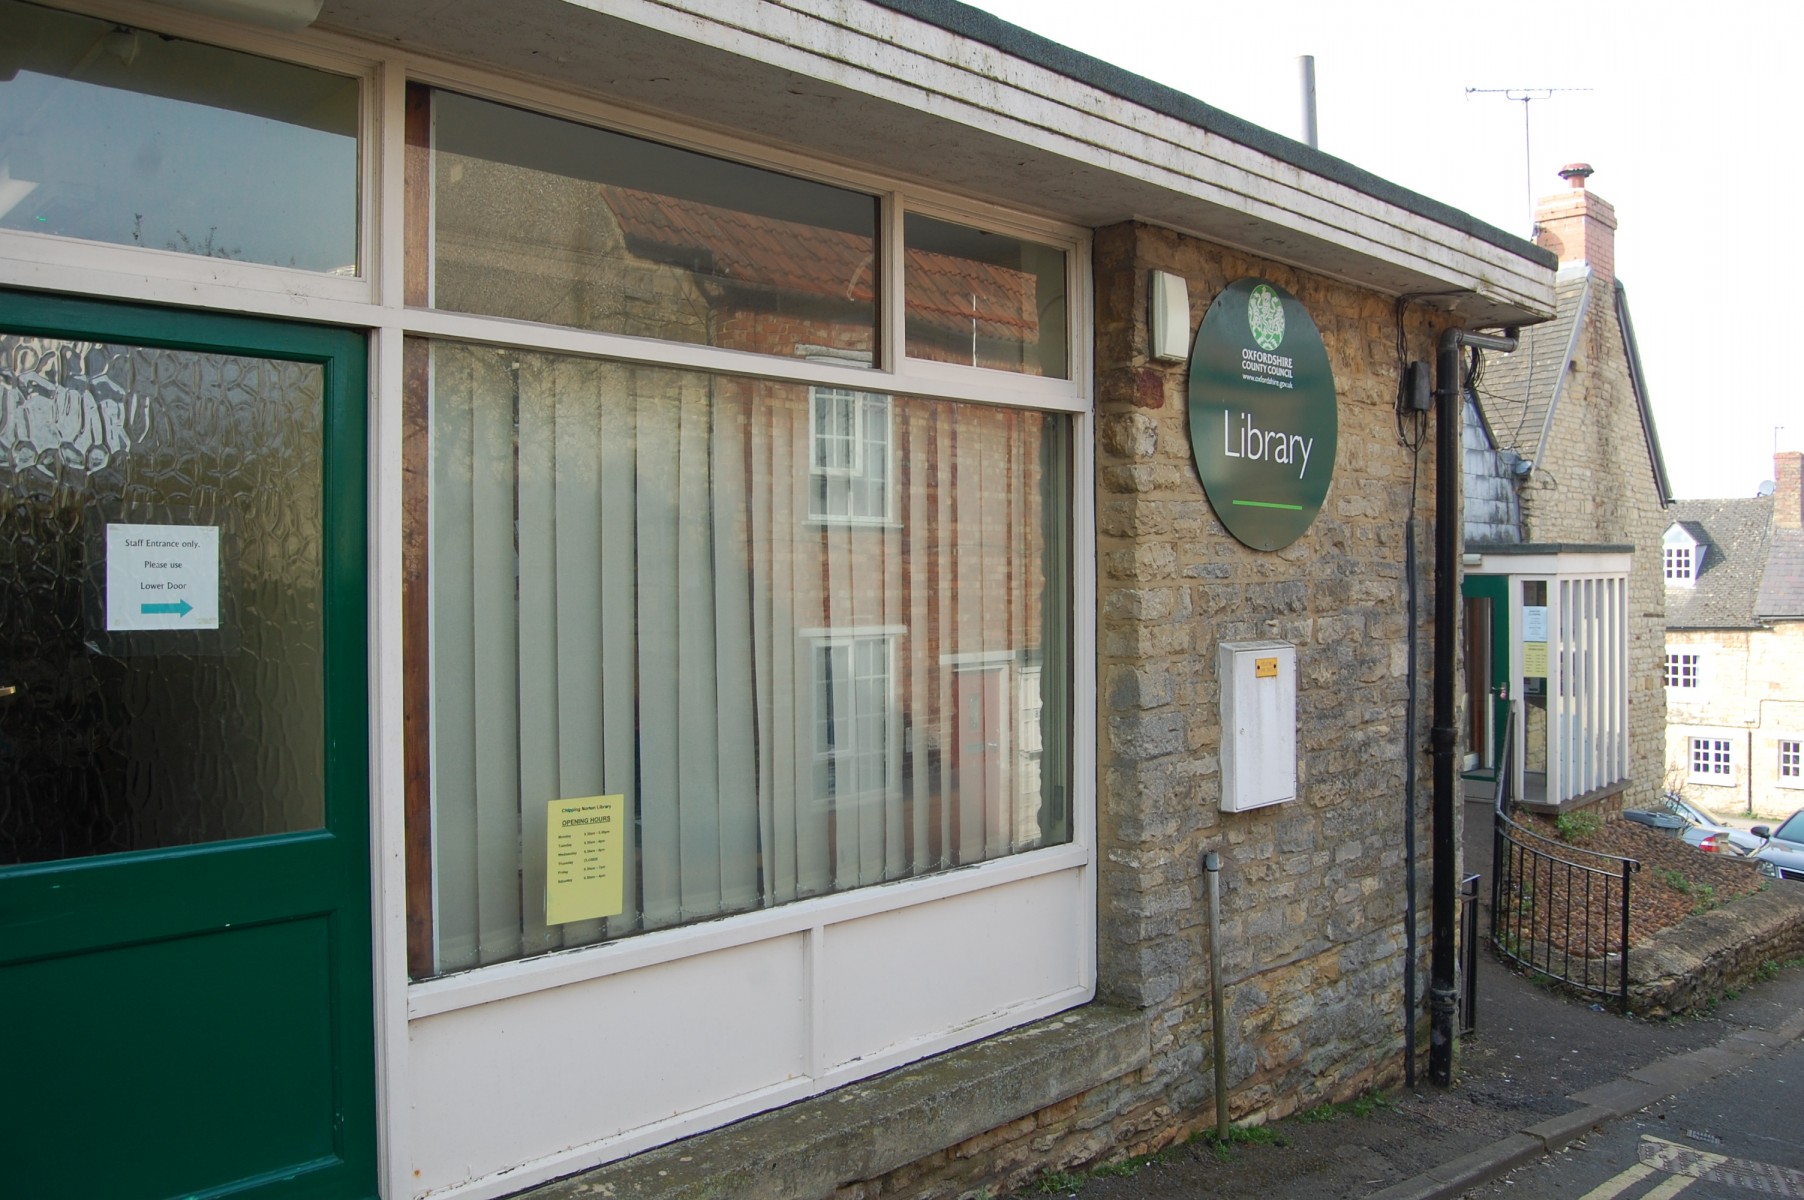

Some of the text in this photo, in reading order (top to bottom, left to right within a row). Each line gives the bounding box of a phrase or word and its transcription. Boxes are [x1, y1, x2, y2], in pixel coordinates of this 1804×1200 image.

[1242, 349, 1293, 368] OXFORDSHIRE
[1242, 360, 1293, 378] COUNTY COUNCIL
[1242, 374, 1293, 389] www.oxfordshire.gov.uk
[1224, 409, 1313, 479] Library
[125, 539, 201, 549] Staff Entrance only.
[144, 561, 168, 569] Please
[140, 582, 187, 590] Lower Door
[561, 815, 611, 827] OPENING HOURS
